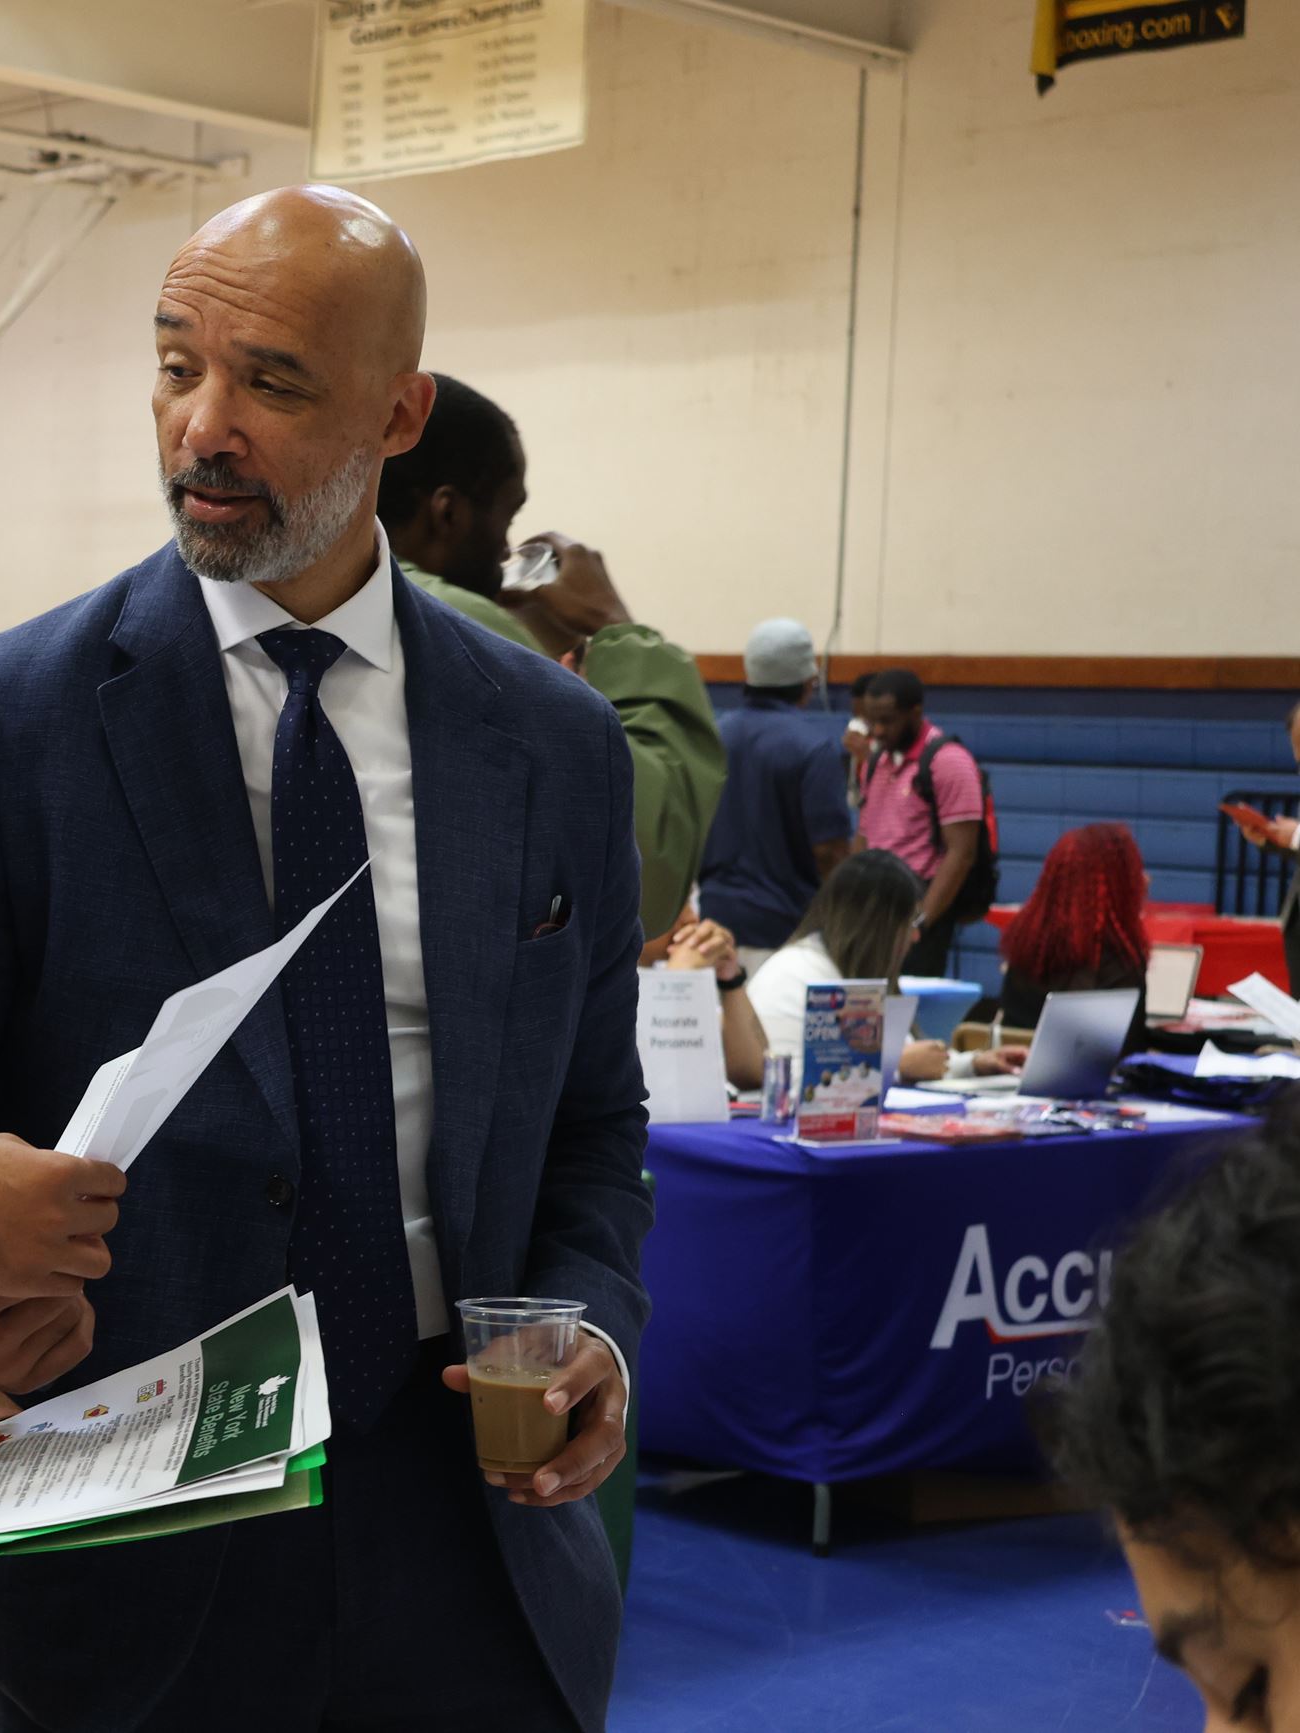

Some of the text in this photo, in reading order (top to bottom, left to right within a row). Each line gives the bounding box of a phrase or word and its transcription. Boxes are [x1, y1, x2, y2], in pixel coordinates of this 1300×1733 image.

[651, 1016, 698, 1028] Accurate
[650, 1036, 704, 1049] Personnel
[192, 1380, 230, 1458] State Benefits
[220, 1383, 252, 1442] New York
